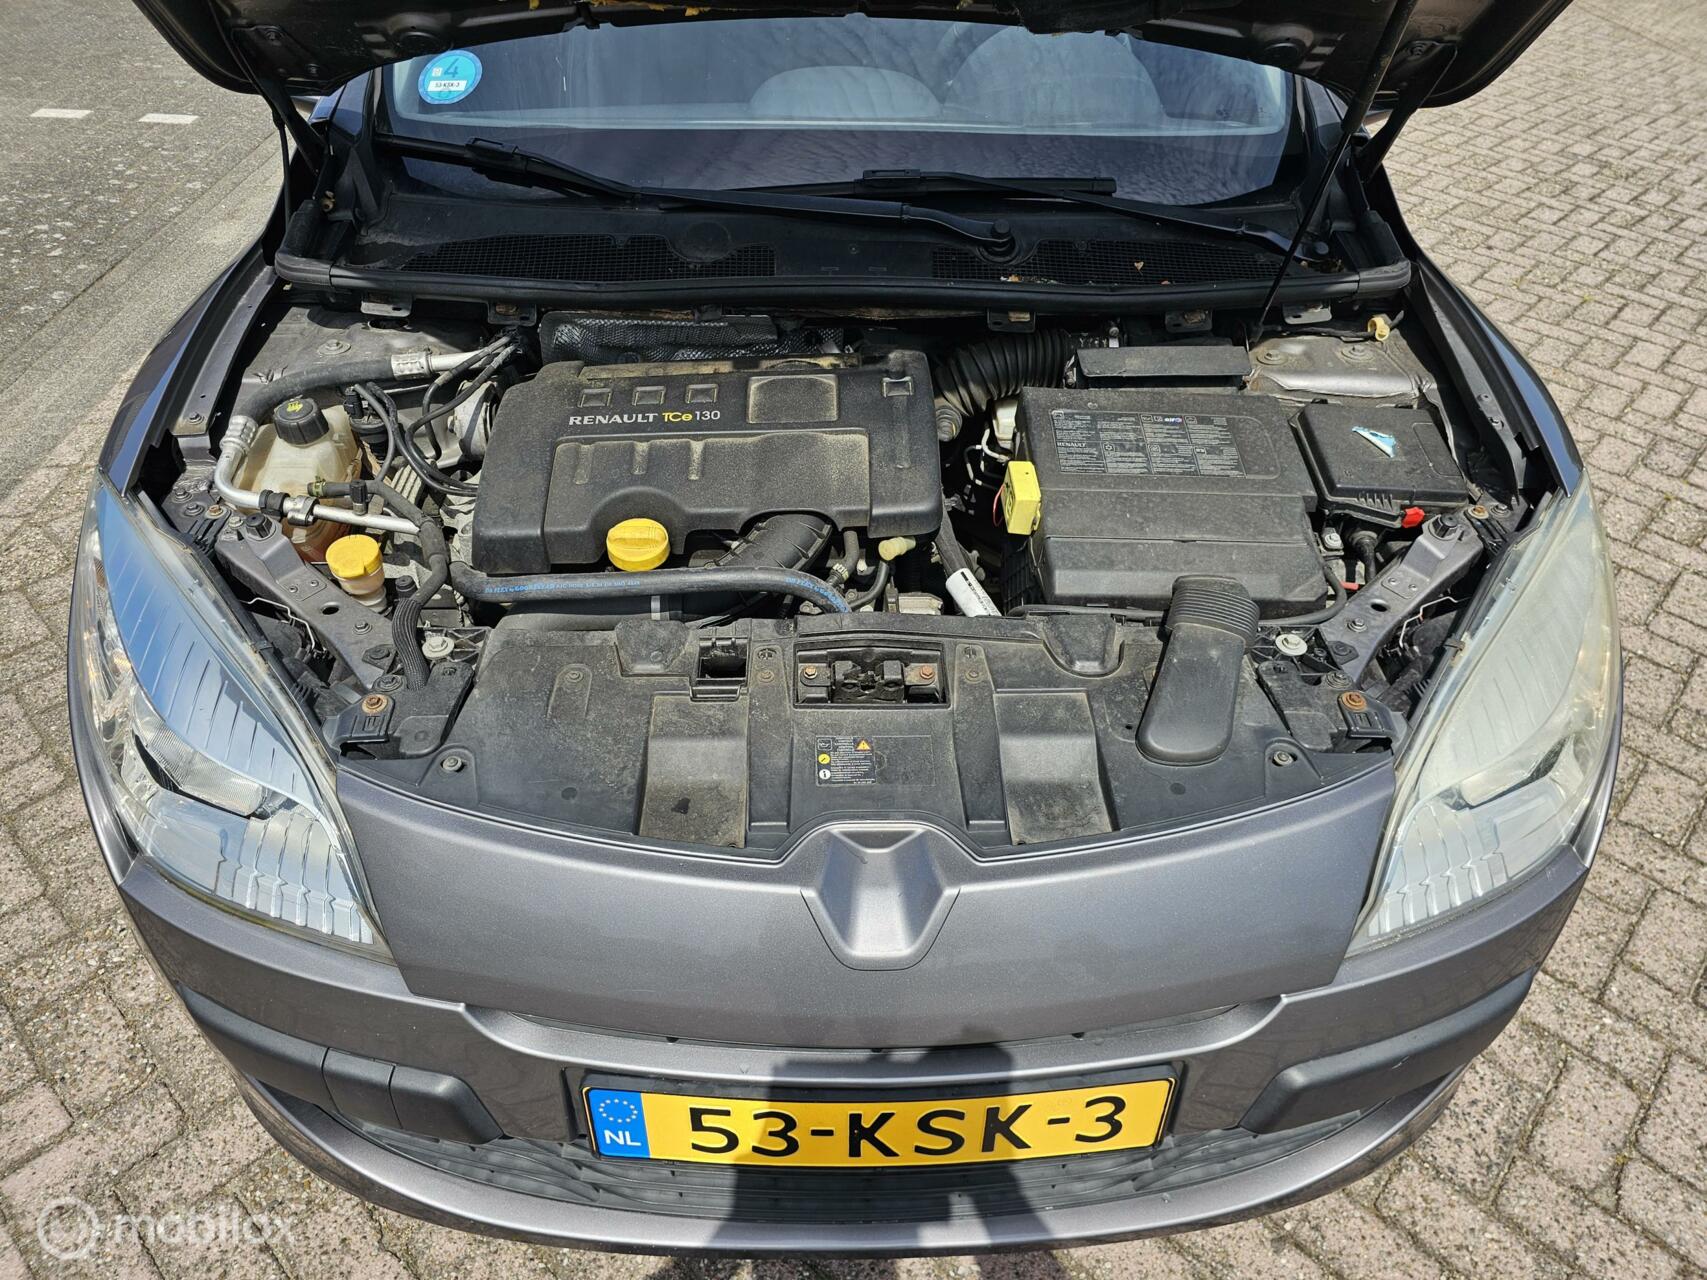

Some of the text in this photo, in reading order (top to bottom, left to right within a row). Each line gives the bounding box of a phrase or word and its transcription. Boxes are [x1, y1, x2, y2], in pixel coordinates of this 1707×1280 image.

[444, 57, 459, 78] 4
[568, 410, 721, 425] RENAULT TCe 130
[689, 1095, 1126, 1159] 53-KSK-3
[604, 1129, 641, 1147] NL
